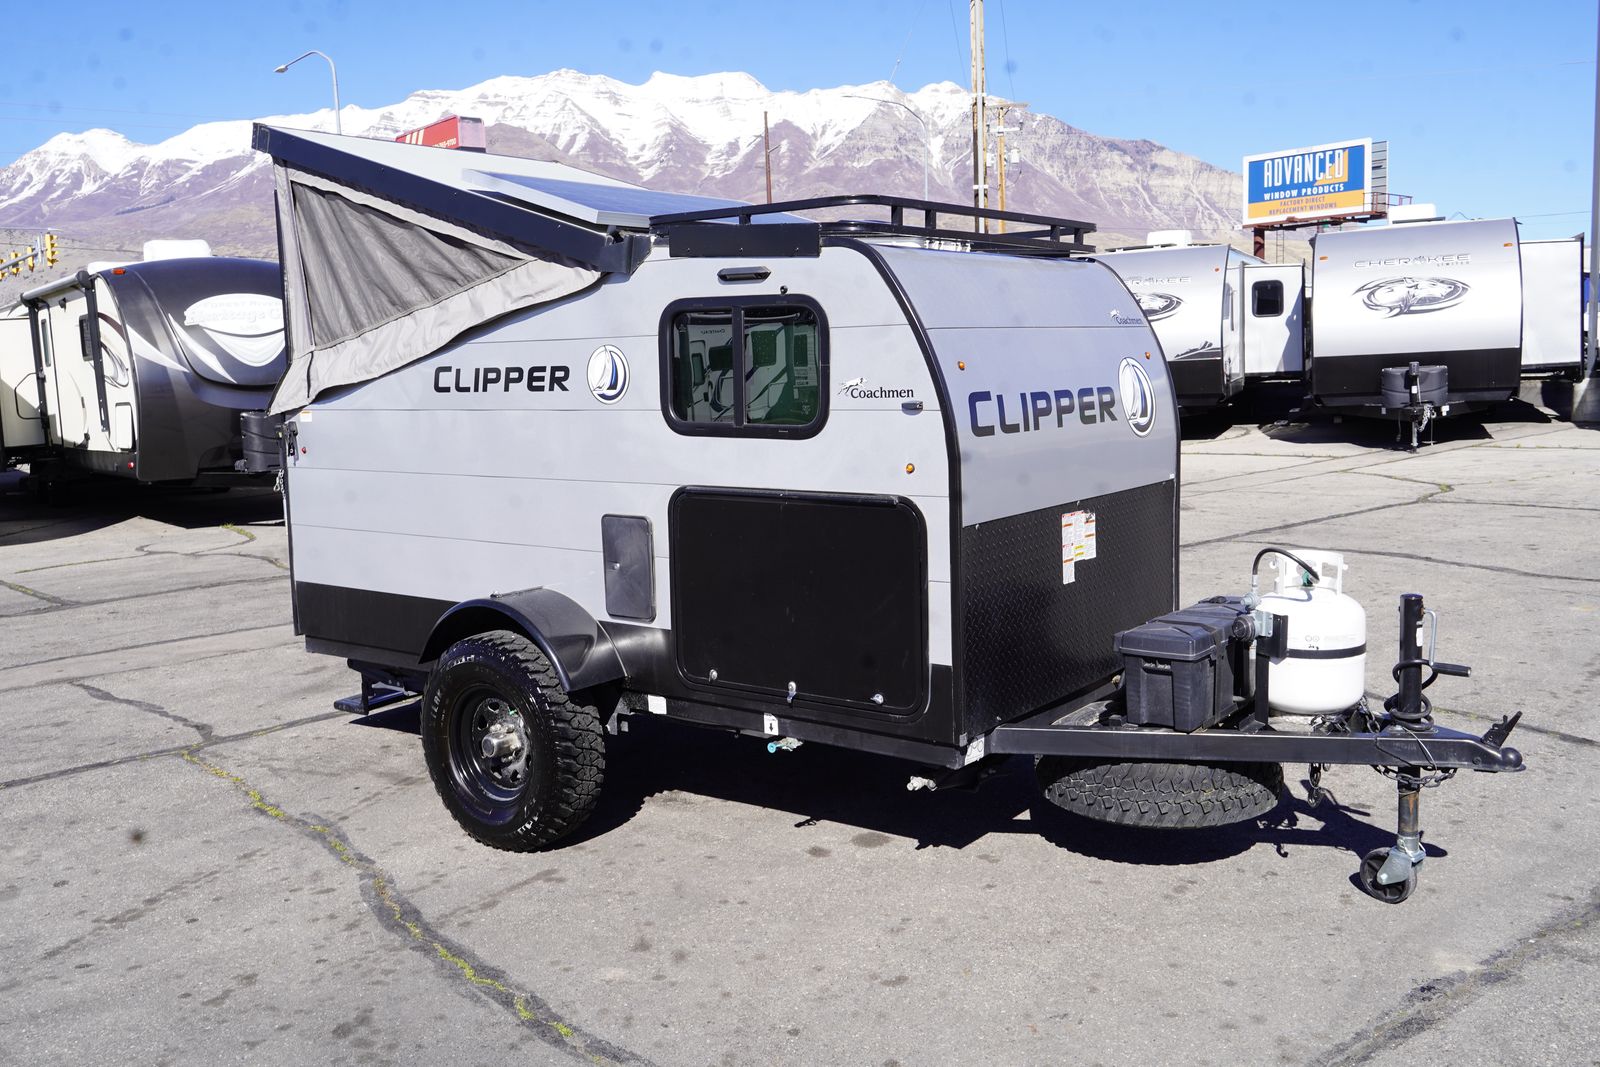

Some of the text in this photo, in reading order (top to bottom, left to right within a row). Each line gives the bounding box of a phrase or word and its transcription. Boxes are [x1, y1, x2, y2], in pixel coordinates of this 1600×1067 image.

[1264, 149, 1344, 188] ADVANCED
[1263, 183, 1345, 201] WINDOW PRODUCTS
[1269, 202, 1336, 215] REPLACEMENT WINDOWS
[1280, 196, 1325, 207] FACTORY DIRECT
[433, 365, 570, 393] CLIPPER
[850, 386, 914, 399] Coachmen
[968, 386, 1118, 438] CLIPPER
